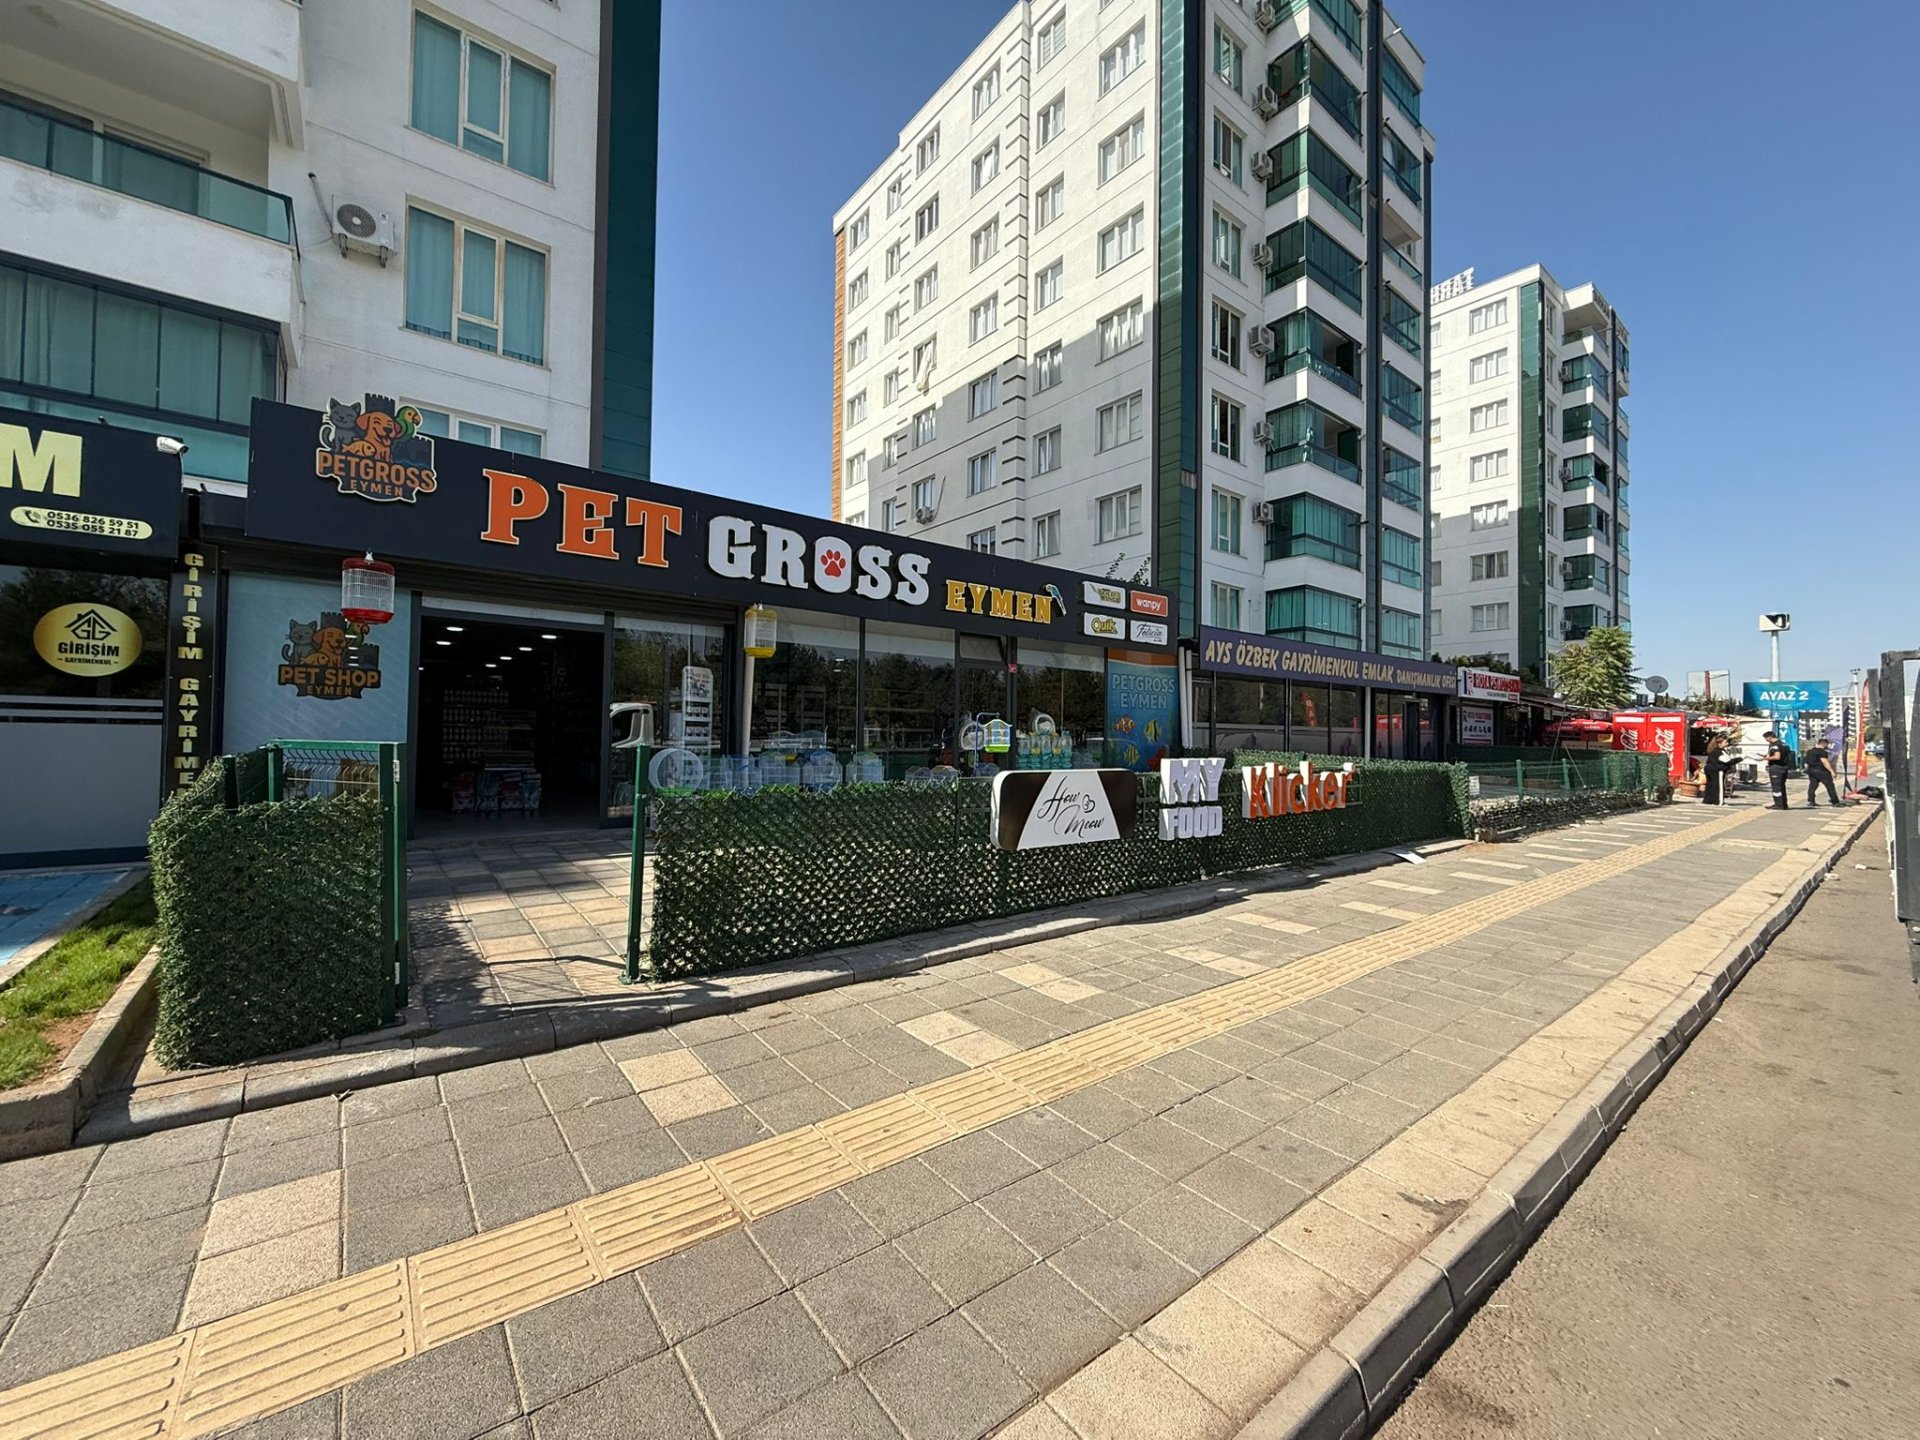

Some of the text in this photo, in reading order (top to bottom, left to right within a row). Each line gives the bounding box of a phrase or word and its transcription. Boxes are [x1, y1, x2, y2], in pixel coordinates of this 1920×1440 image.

[318, 451, 434, 491] PETGROSS
[350, 480, 403, 497] EYMEN
[46, 511, 80, 522] 0536
[83, 515, 106, 525] 826
[109, 519, 124, 528] 59
[46, 520, 139, 537] 0535 055 21 87
[481, 468, 1052, 624] PET GROSS EYMEN
[1136, 598, 1162, 611] wanpy
[1091, 617, 1118, 634] Quik
[58, 641, 119, 657] GİRİŞİM
[1205, 640, 1233, 664] AYS
[1236, 639, 1280, 671] ÖZBEK
[1281, 649, 1360, 679] GAYRİMENKUL
[1362, 661, 1394, 683] EMLAK
[280, 666, 379, 687] PET SHOP
[1112, 673, 1176, 693] PETGROSS
[306, 685, 352, 696] EYMEN
[1760, 691, 1809, 700] AYAZ 2
[1120, 692, 1168, 709] EYMEN
[174, 678, 200, 797] GAYRİME
[1161, 758, 1226, 804] MY
[1242, 761, 1355, 819] Klicker
[1158, 806, 1223, 840] FOOD
